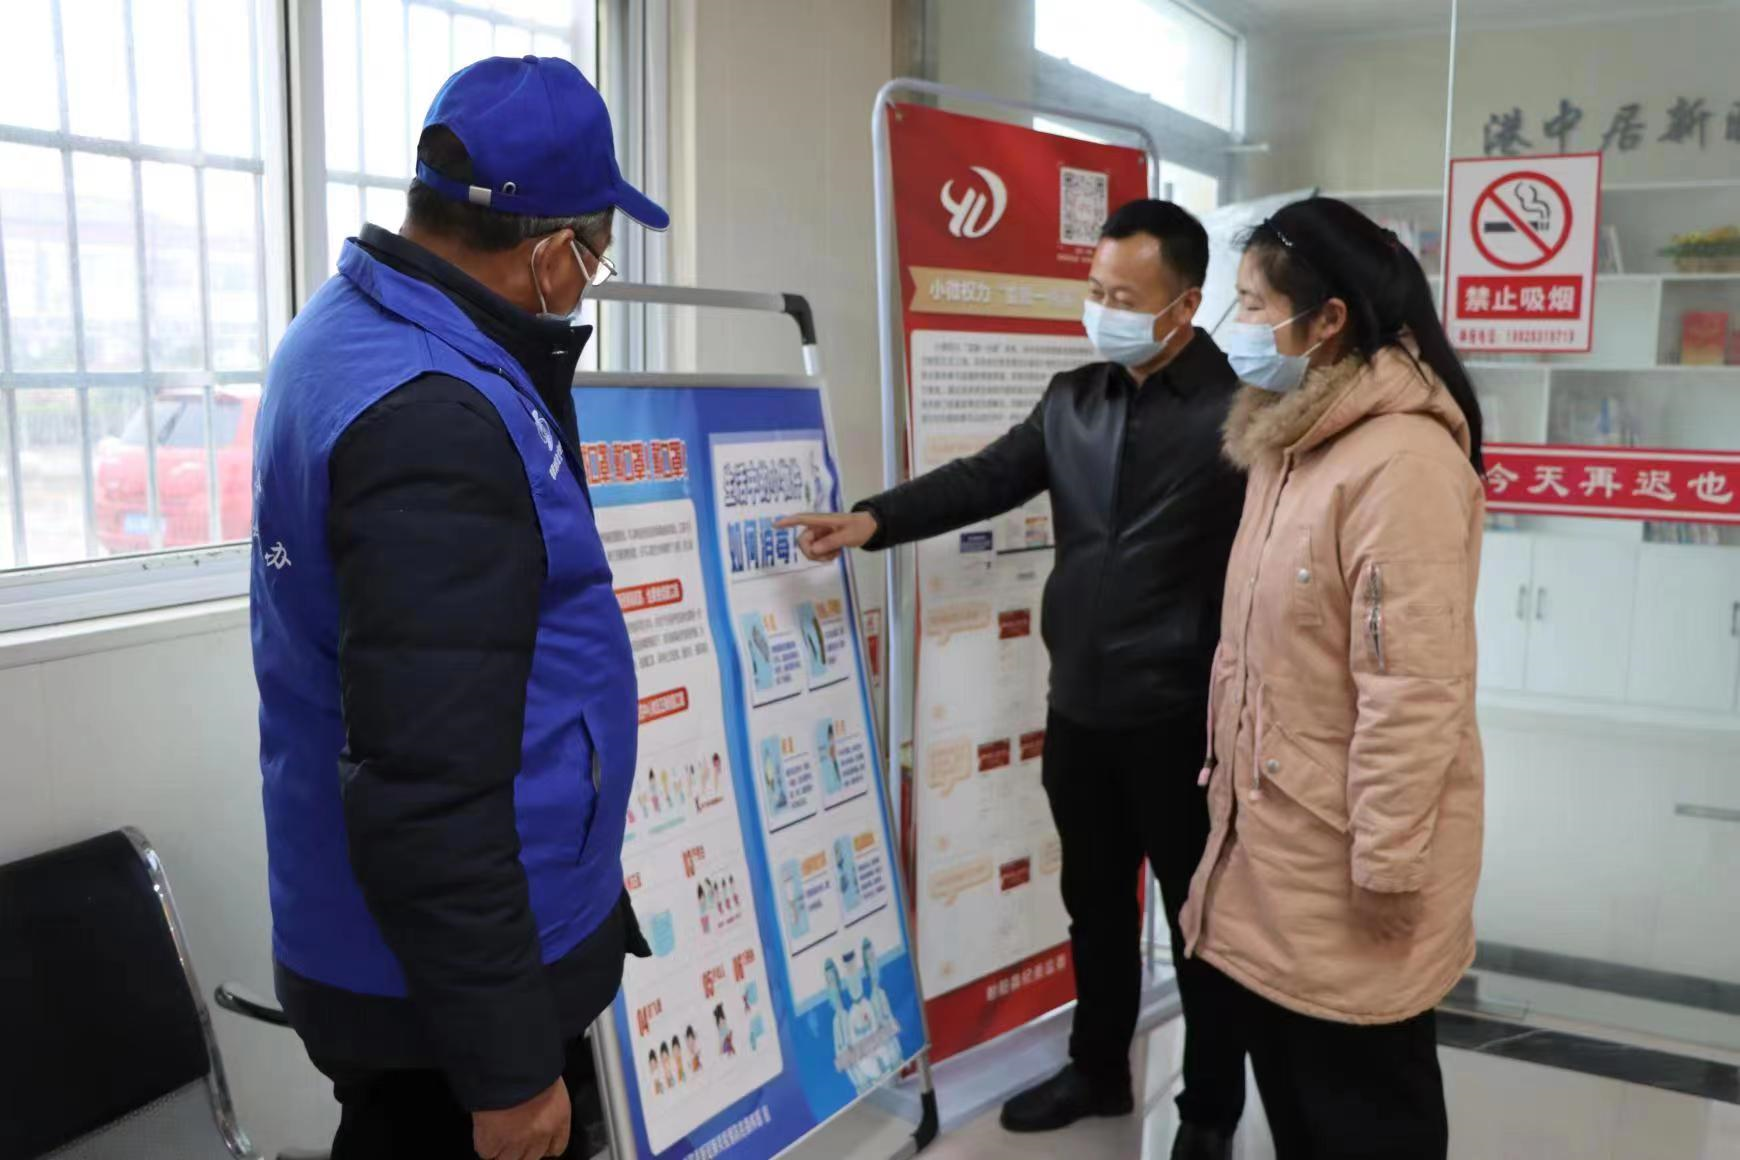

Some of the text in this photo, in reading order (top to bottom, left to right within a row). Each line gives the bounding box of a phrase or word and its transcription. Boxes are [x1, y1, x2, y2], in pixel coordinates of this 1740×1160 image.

[1465, 285, 1575, 312] 禁止吸烟
[1487, 463, 1734, 505] 今天再迟也
